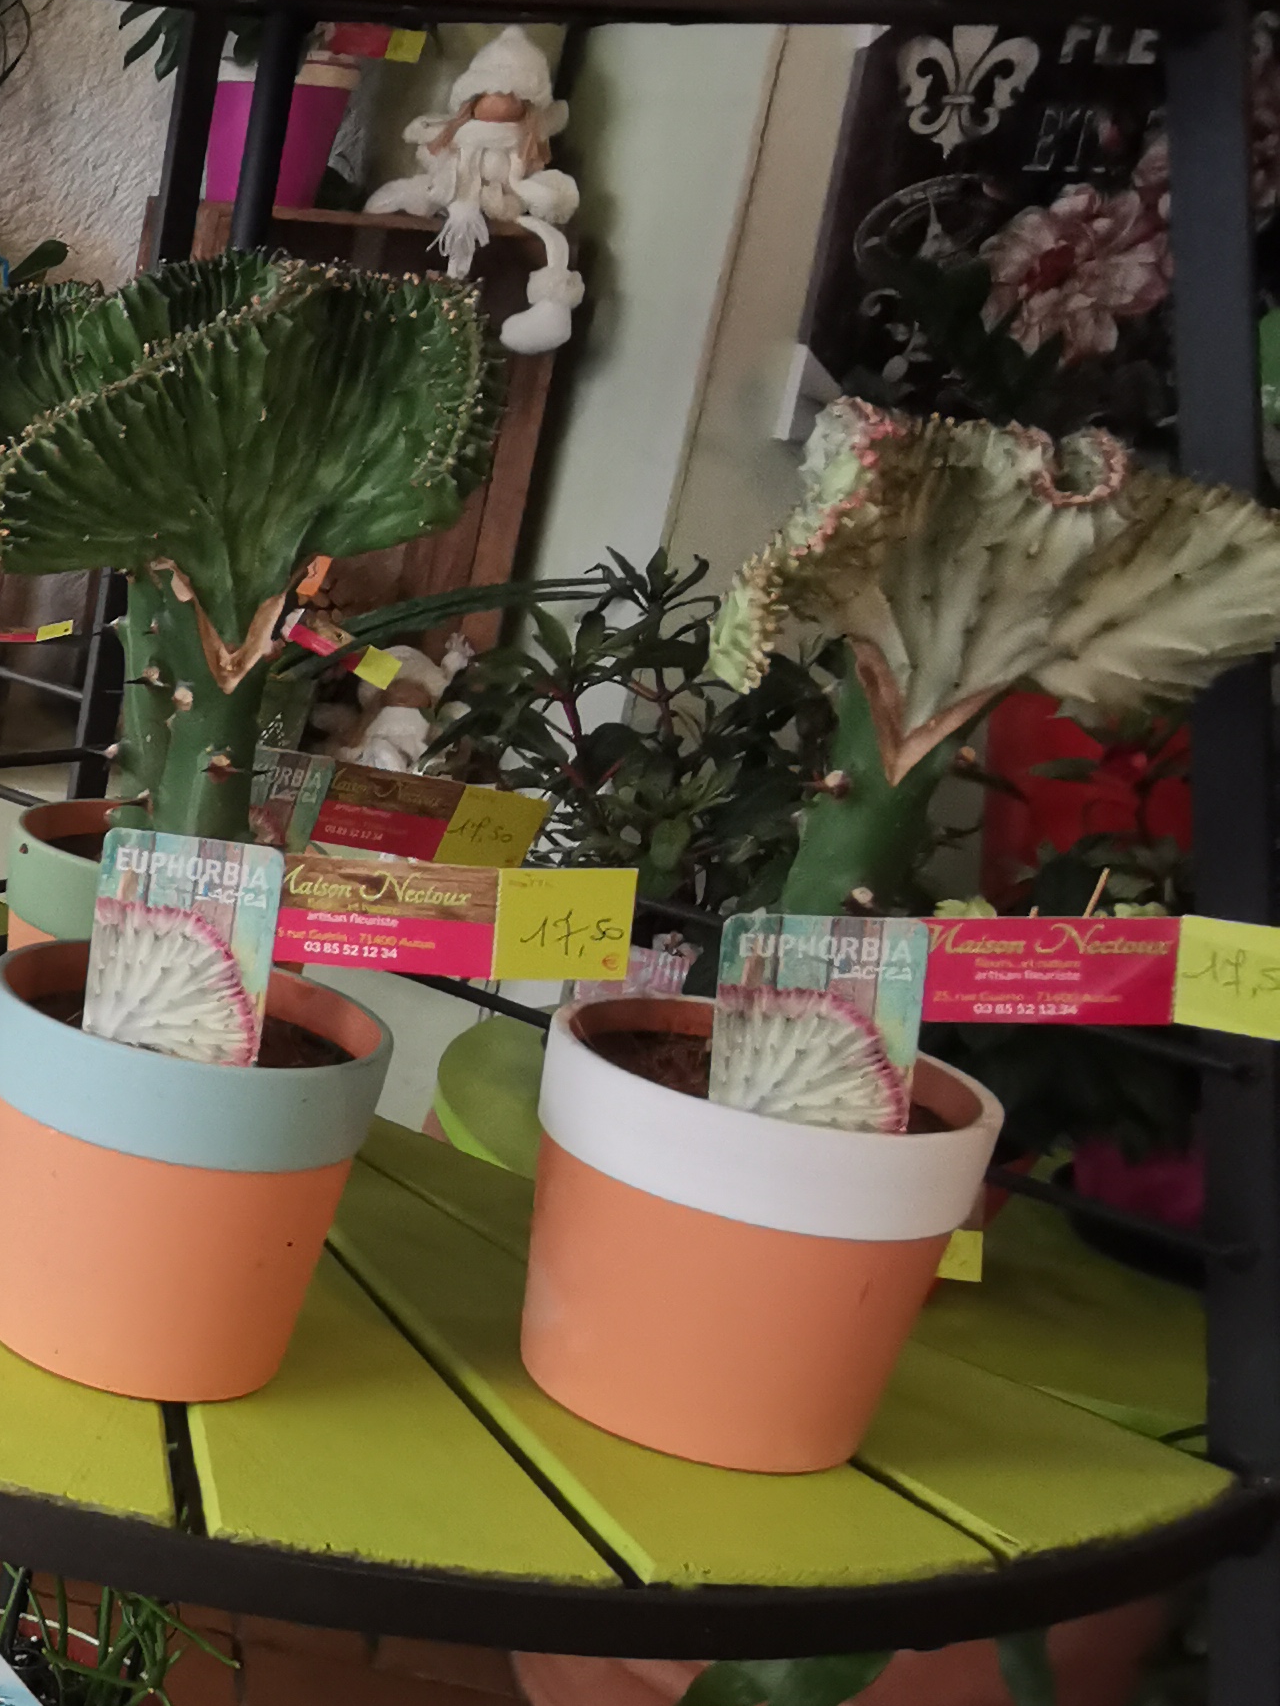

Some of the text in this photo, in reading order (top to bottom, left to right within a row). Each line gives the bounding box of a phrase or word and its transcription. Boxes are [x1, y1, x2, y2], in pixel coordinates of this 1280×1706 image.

[115, 846, 270, 890] EUPHORBIA
[359, 870, 473, 906] Nectoux
[304, 940, 399, 960] 03 85 52 12 34
[519, 908, 625, 959] 17,50
[738, 933, 913, 964] EUPHORBIA
[1035, 922, 1169, 956] Nectoux
